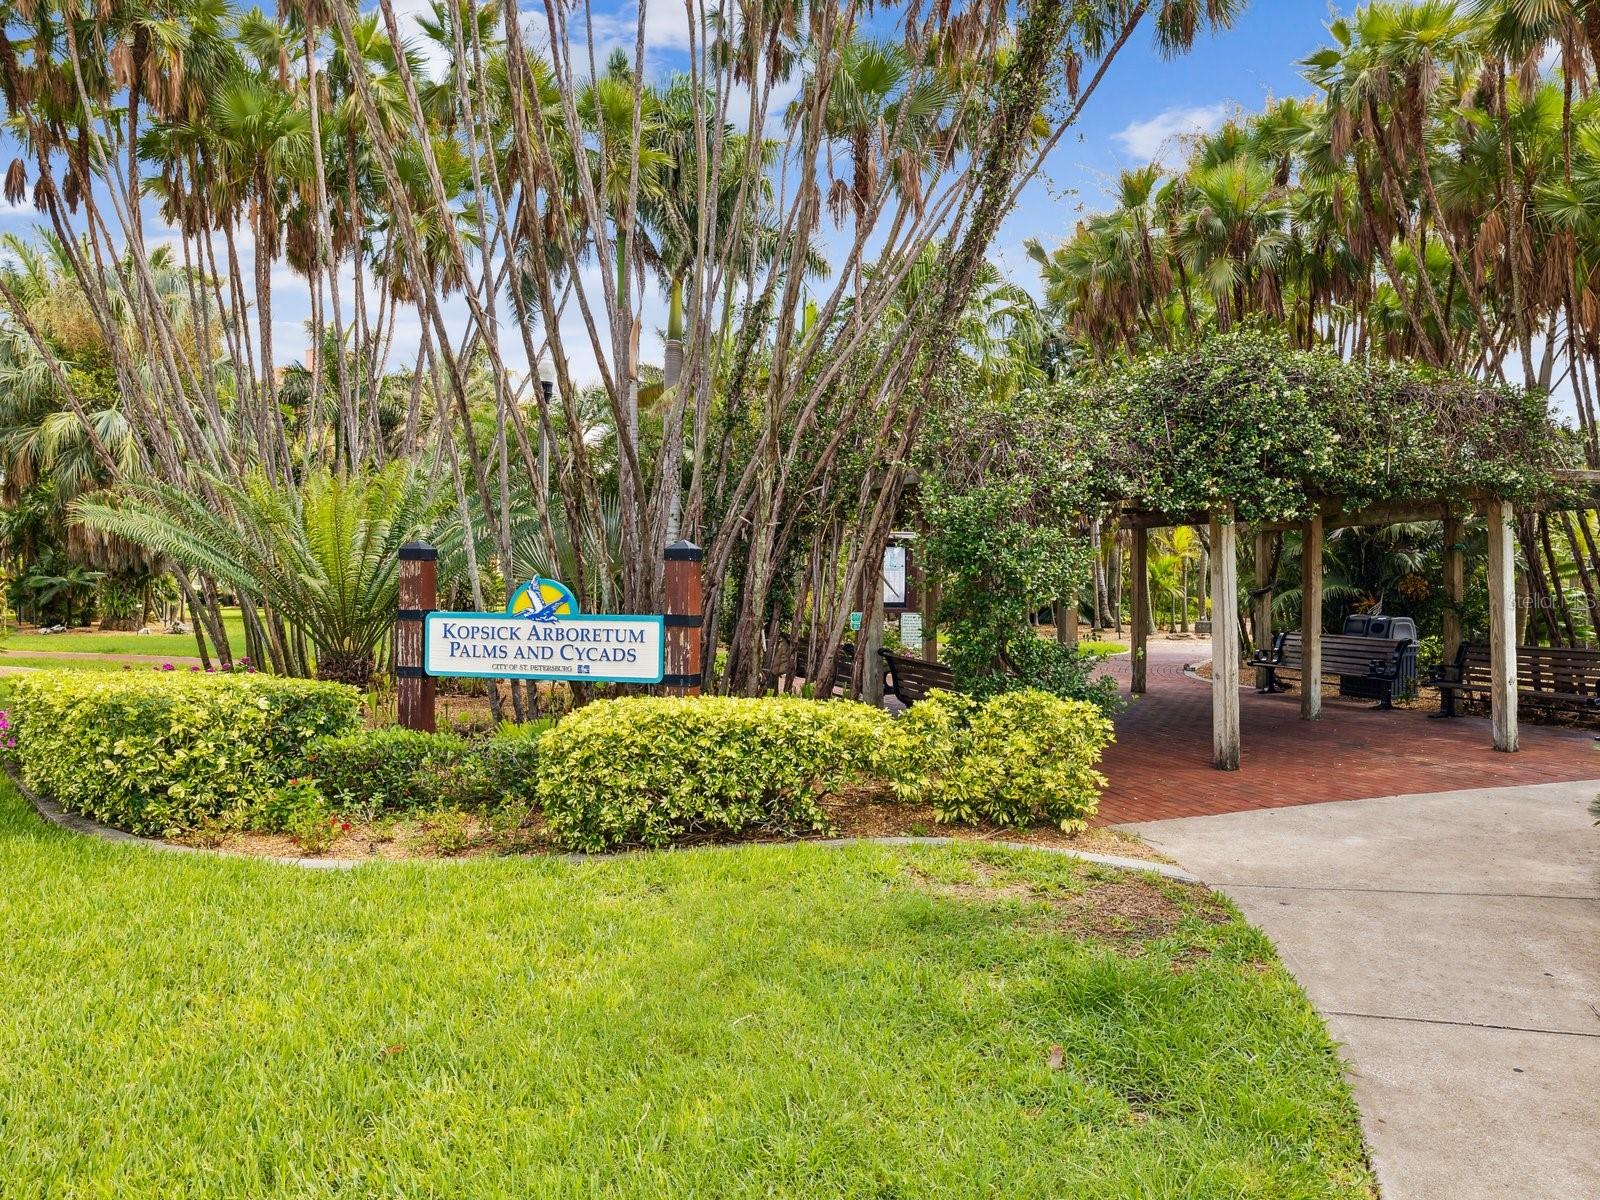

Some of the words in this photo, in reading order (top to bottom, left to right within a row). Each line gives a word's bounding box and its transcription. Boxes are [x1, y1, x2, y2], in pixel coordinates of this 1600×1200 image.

[442, 623, 521, 641] KOPSICK
[527, 625, 645, 643] ARBORETUM
[449, 641, 508, 659] PALMS
[514, 645, 553, 660] AND
[560, 644, 637, 662] CYCADS
